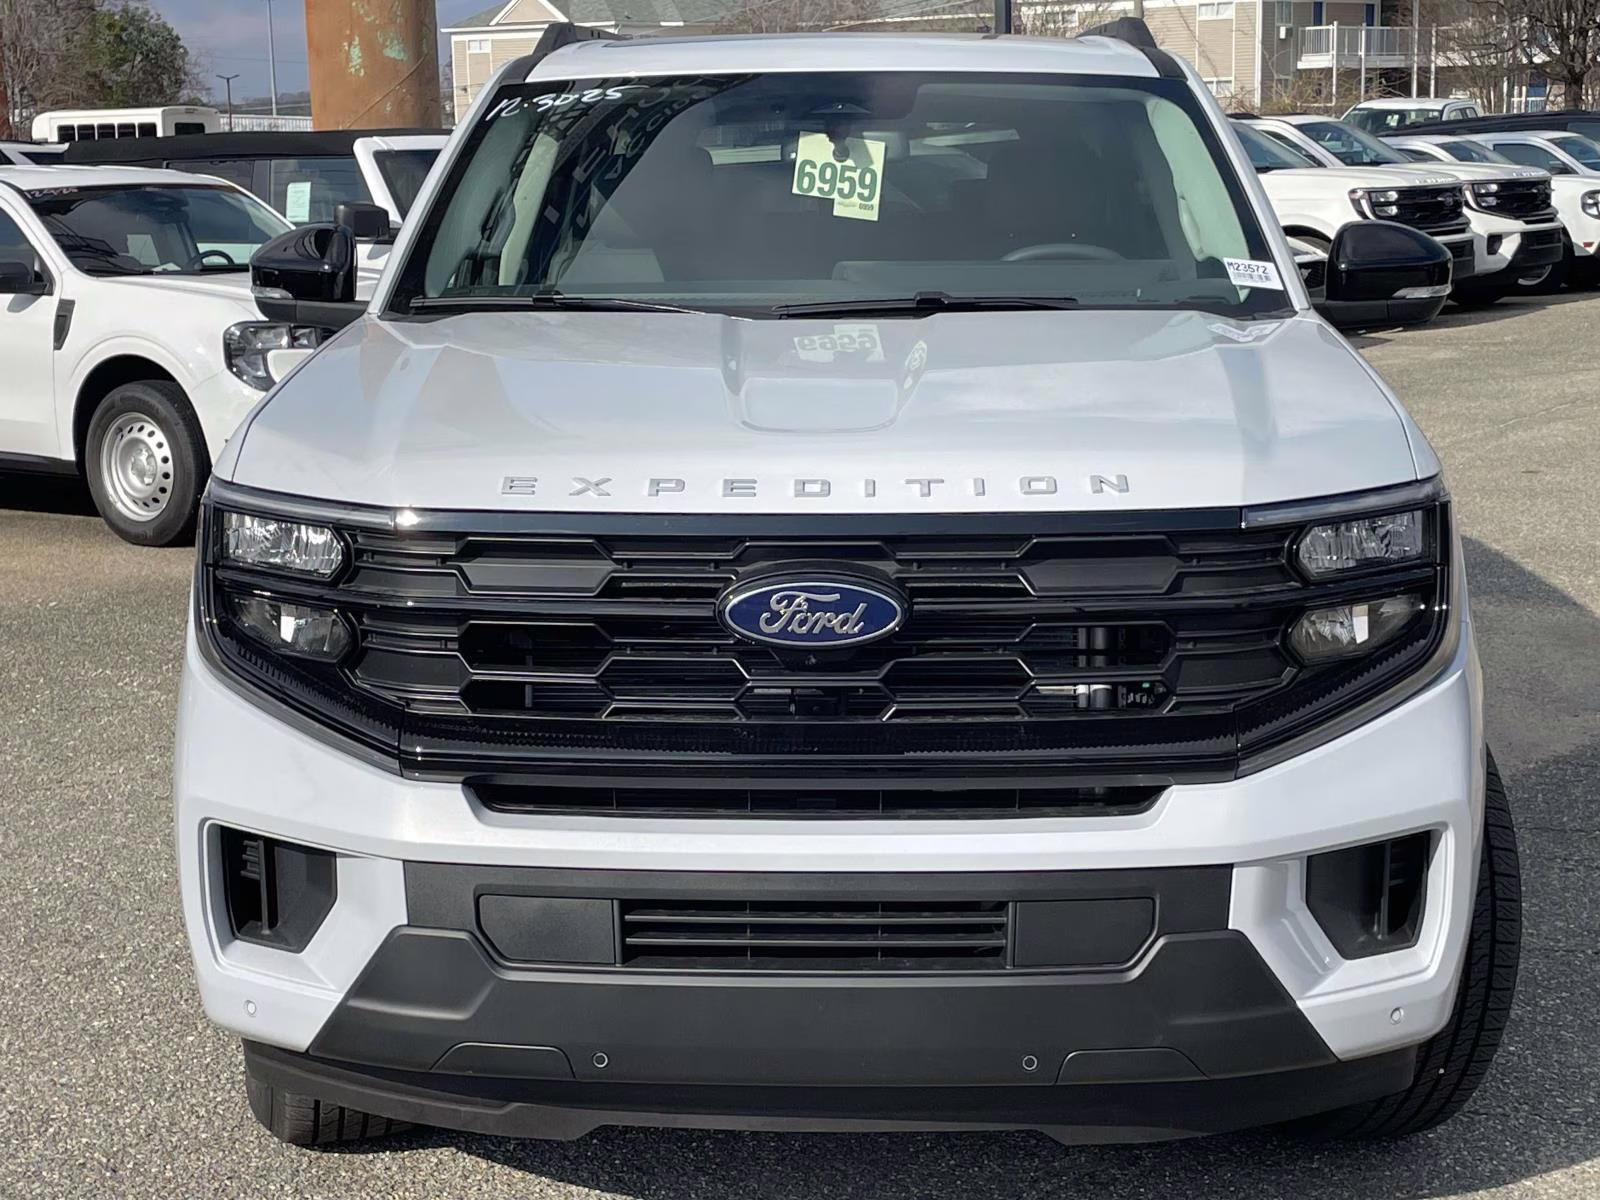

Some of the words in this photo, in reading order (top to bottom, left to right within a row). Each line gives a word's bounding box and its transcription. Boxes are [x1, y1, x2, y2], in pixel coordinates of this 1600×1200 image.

[797, 160, 878, 202] 6959
[1226, 261, 1270, 275] M23572
[501, 474, 1130, 498] EXPEDITION
[759, 591, 867, 634] Ford
